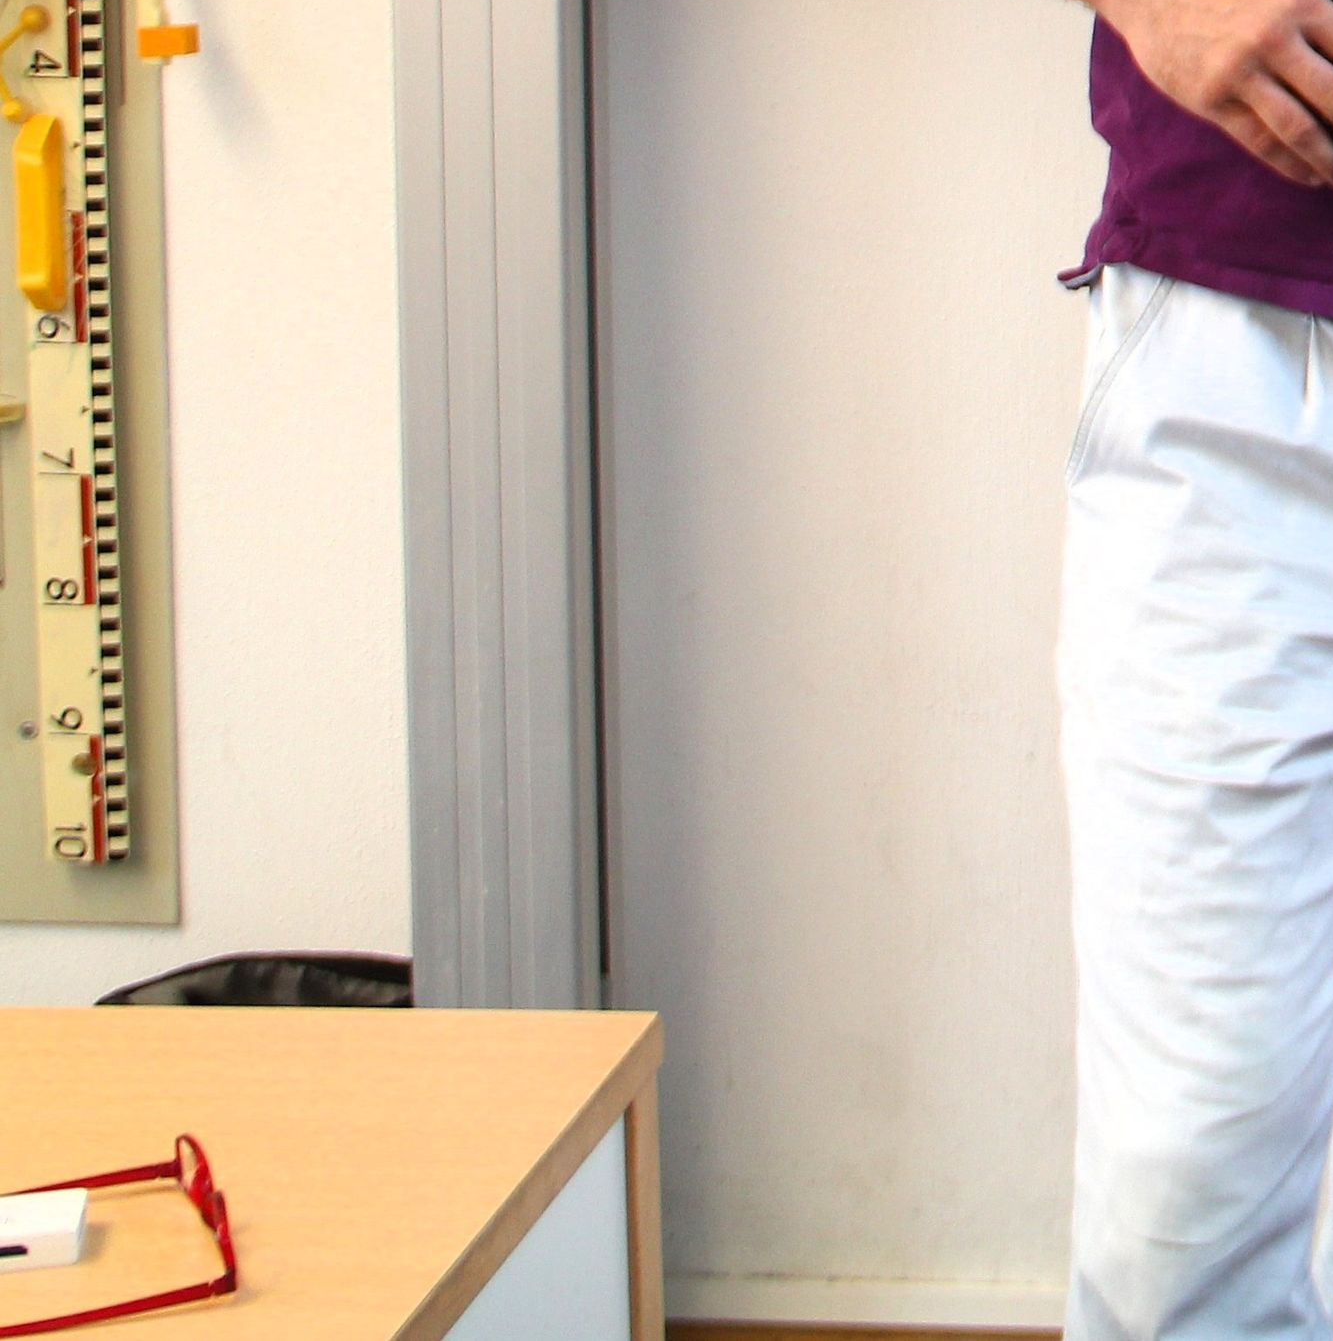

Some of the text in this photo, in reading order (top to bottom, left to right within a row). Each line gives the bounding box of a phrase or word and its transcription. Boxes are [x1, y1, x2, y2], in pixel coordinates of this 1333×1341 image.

[30, 49, 62, 74] 4
[42, 446, 74, 470] 7
[46, 577, 79, 601] 8
[54, 821, 88, 861] 10
